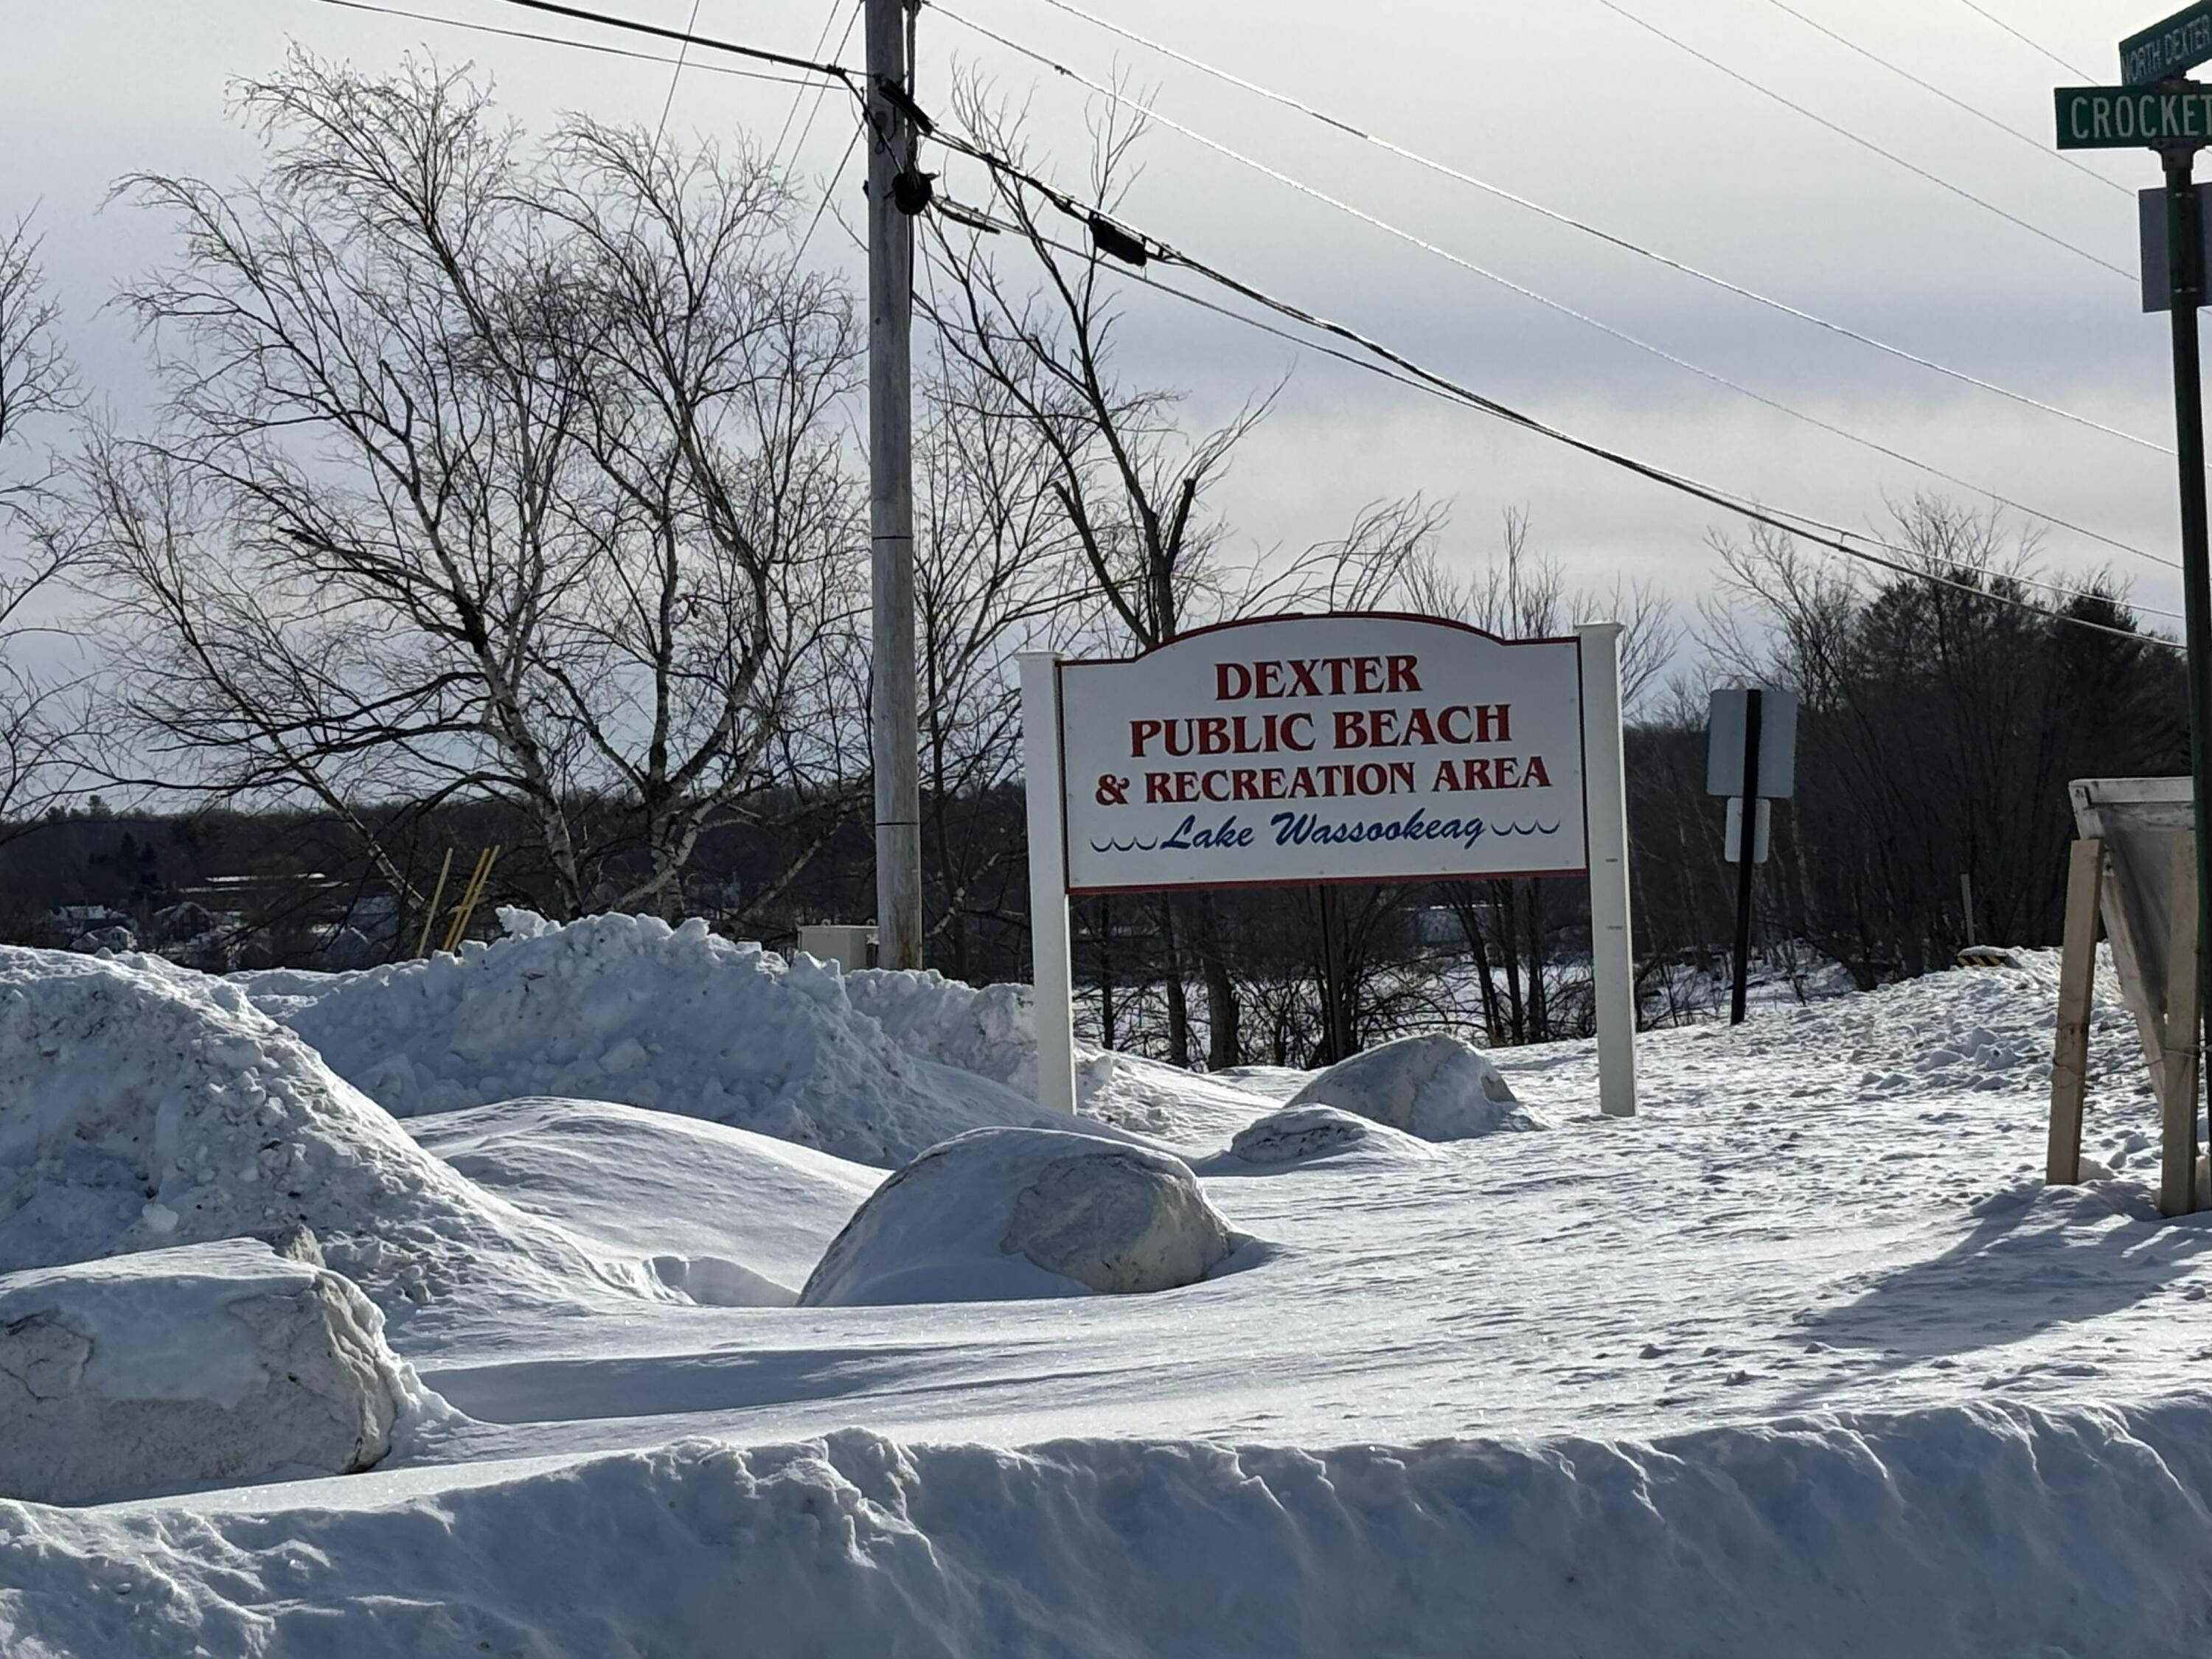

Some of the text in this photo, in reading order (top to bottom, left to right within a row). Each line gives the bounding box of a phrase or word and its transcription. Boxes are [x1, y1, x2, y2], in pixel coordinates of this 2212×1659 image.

[2123, 14, 2210, 83] NORTH DEXTER
[1215, 655, 1422, 700] DEXTER
[1130, 704, 1512, 757] PUBLIC BEACH
[1096, 756, 1551, 806] & RECREATION AREA
[1160, 808, 1486, 849] Lake Wassookeag
